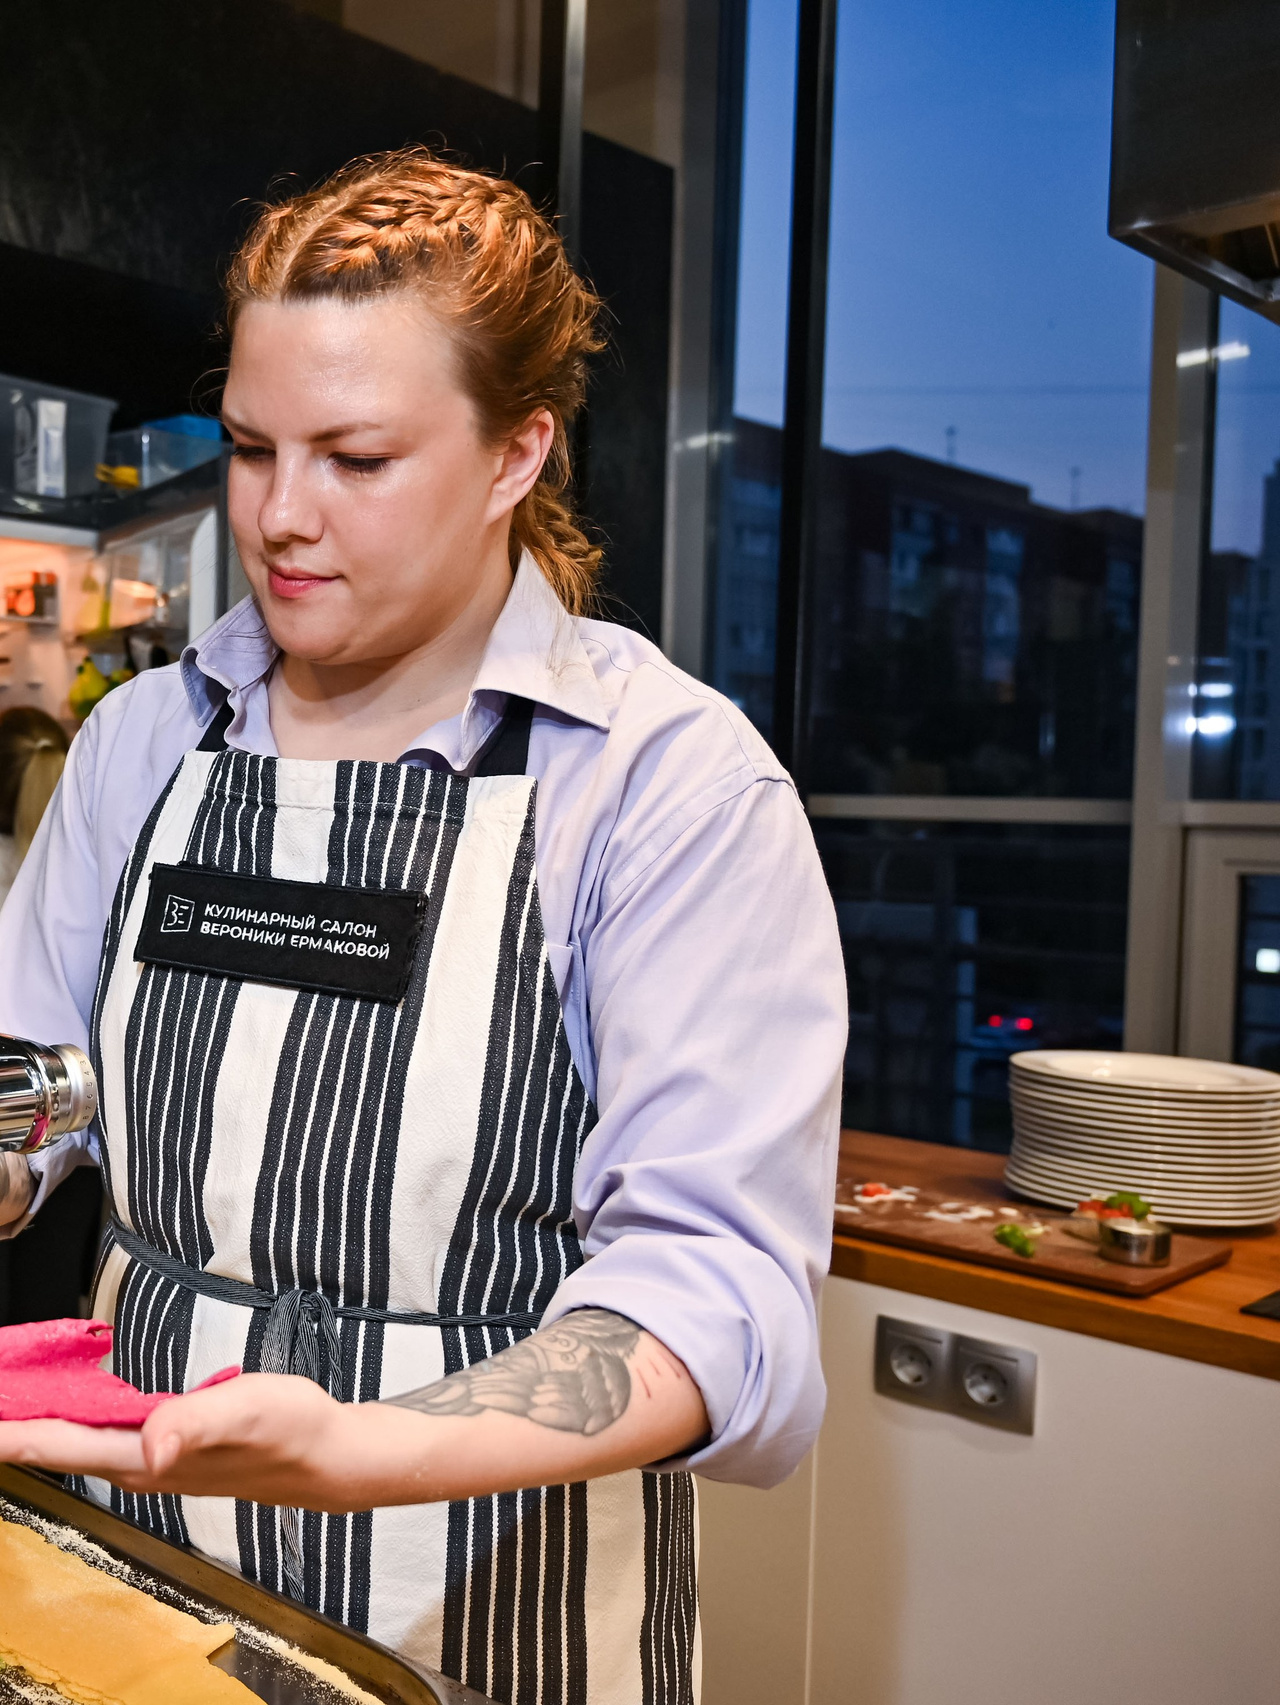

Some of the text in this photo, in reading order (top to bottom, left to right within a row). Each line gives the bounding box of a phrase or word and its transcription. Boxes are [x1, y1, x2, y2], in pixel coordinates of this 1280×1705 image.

[204, 903, 377, 938] КУЛИНАРНЫЙ САЛОН
[200, 921, 390, 960] ВЕРОНИКИ ЕРМАКОВОЙ
